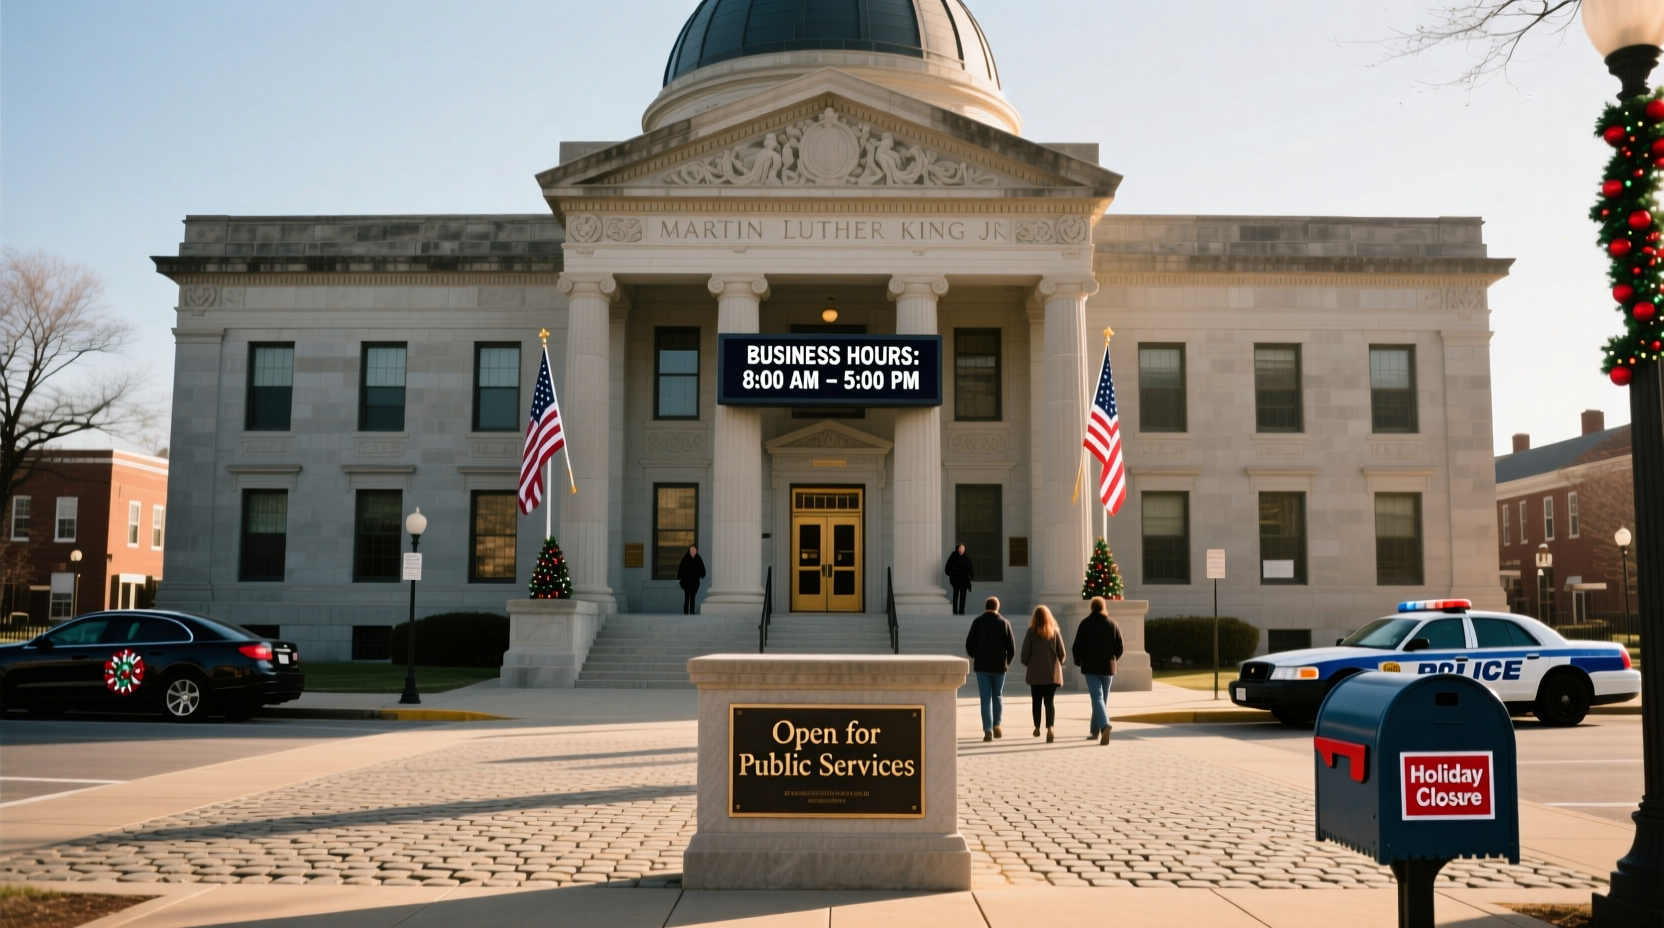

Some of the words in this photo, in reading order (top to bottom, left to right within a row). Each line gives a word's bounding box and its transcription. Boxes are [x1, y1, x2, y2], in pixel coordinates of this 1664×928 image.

[660, 219, 763, 240] MARTIN
[783, 219, 885, 240] LUTHER
[901, 220, 965, 241] KING
[978, 220, 1007, 241] JR
[747, 345, 841, 365] BUSINESS
[847, 346, 920, 366] HOURS:
[742, 369, 784, 390] 8:00
[789, 370, 819, 390] AM
[843, 370, 885, 390] 5:00
[891, 370, 920, 390] PM
[772, 720, 839, 751] Open
[845, 720, 881, 745] for
[738, 752, 812, 777] Public
[819, 752, 915, 777] Services
[1410, 763, 1484, 788] Holiday
